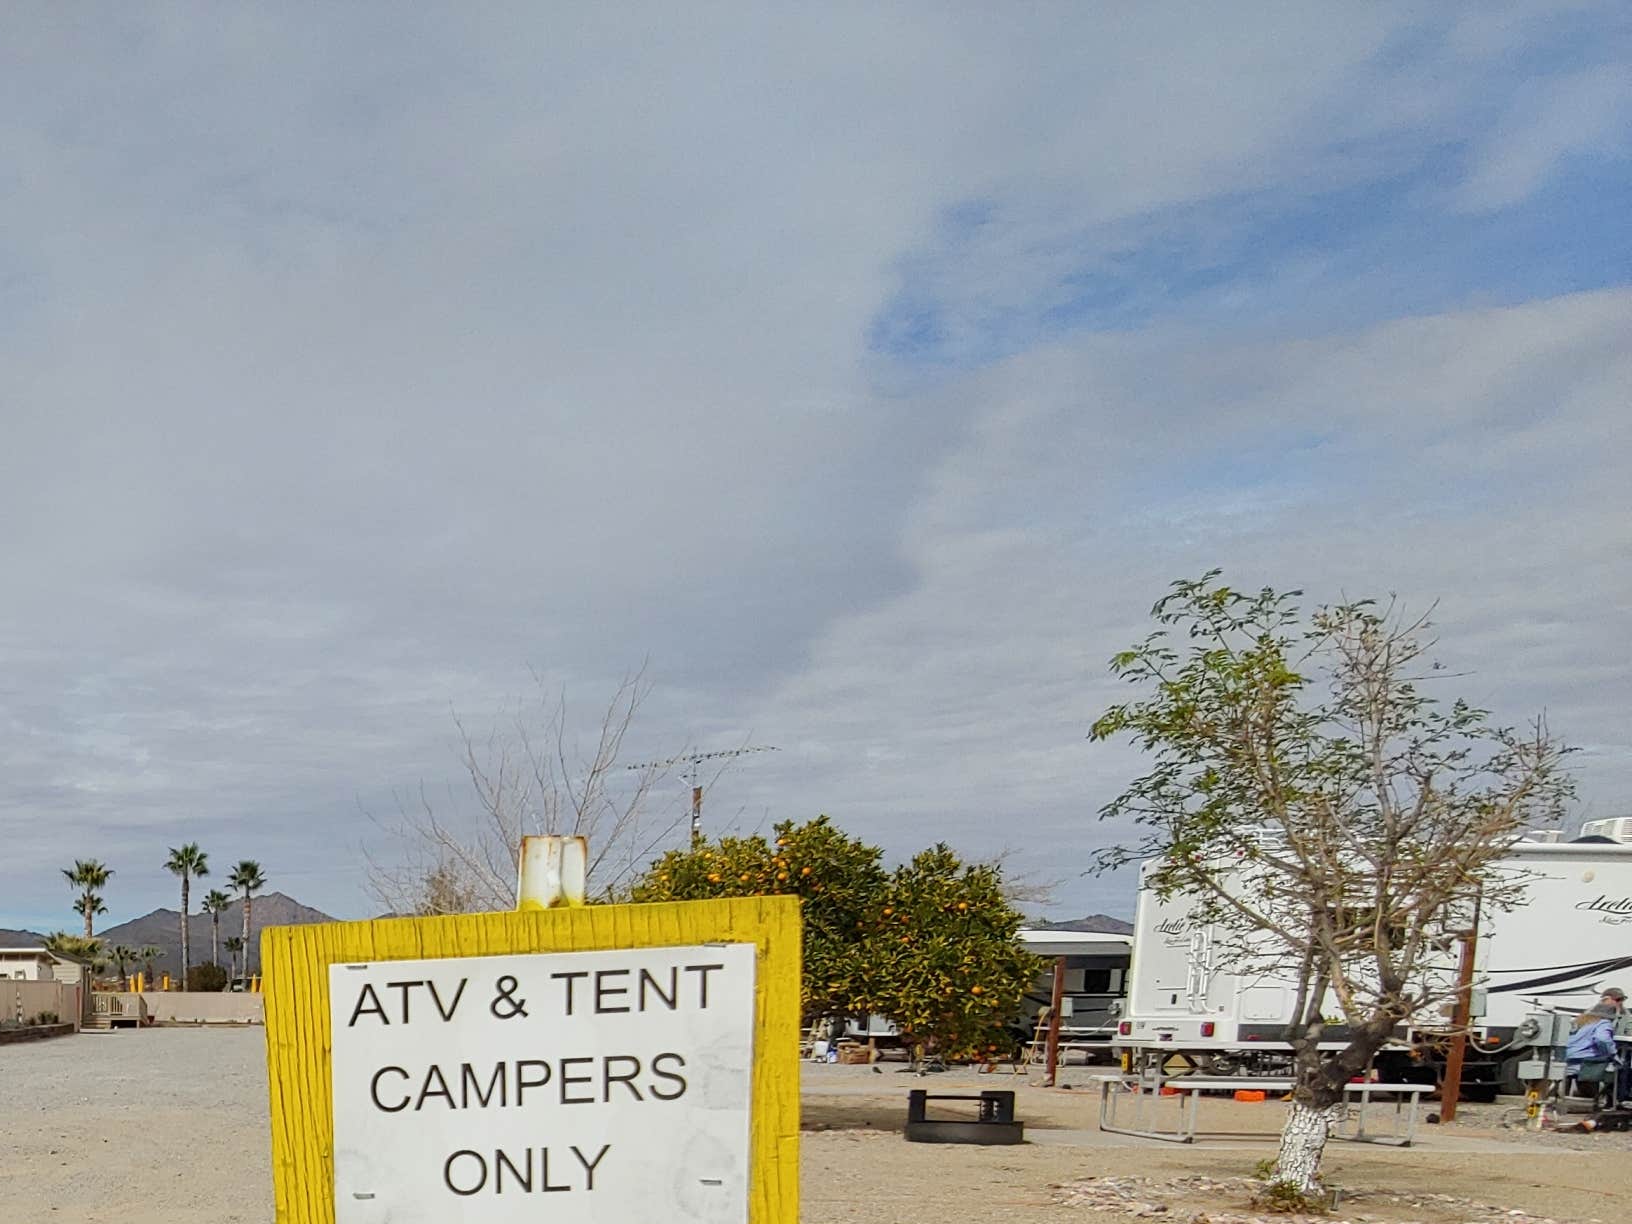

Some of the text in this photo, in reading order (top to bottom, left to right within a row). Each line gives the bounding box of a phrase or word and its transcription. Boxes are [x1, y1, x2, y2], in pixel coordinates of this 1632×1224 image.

[347, 964, 725, 1028] ATV & TENT
[369, 1052, 688, 1113] CAMPERS
[443, 1144, 612, 1197] ONLY
